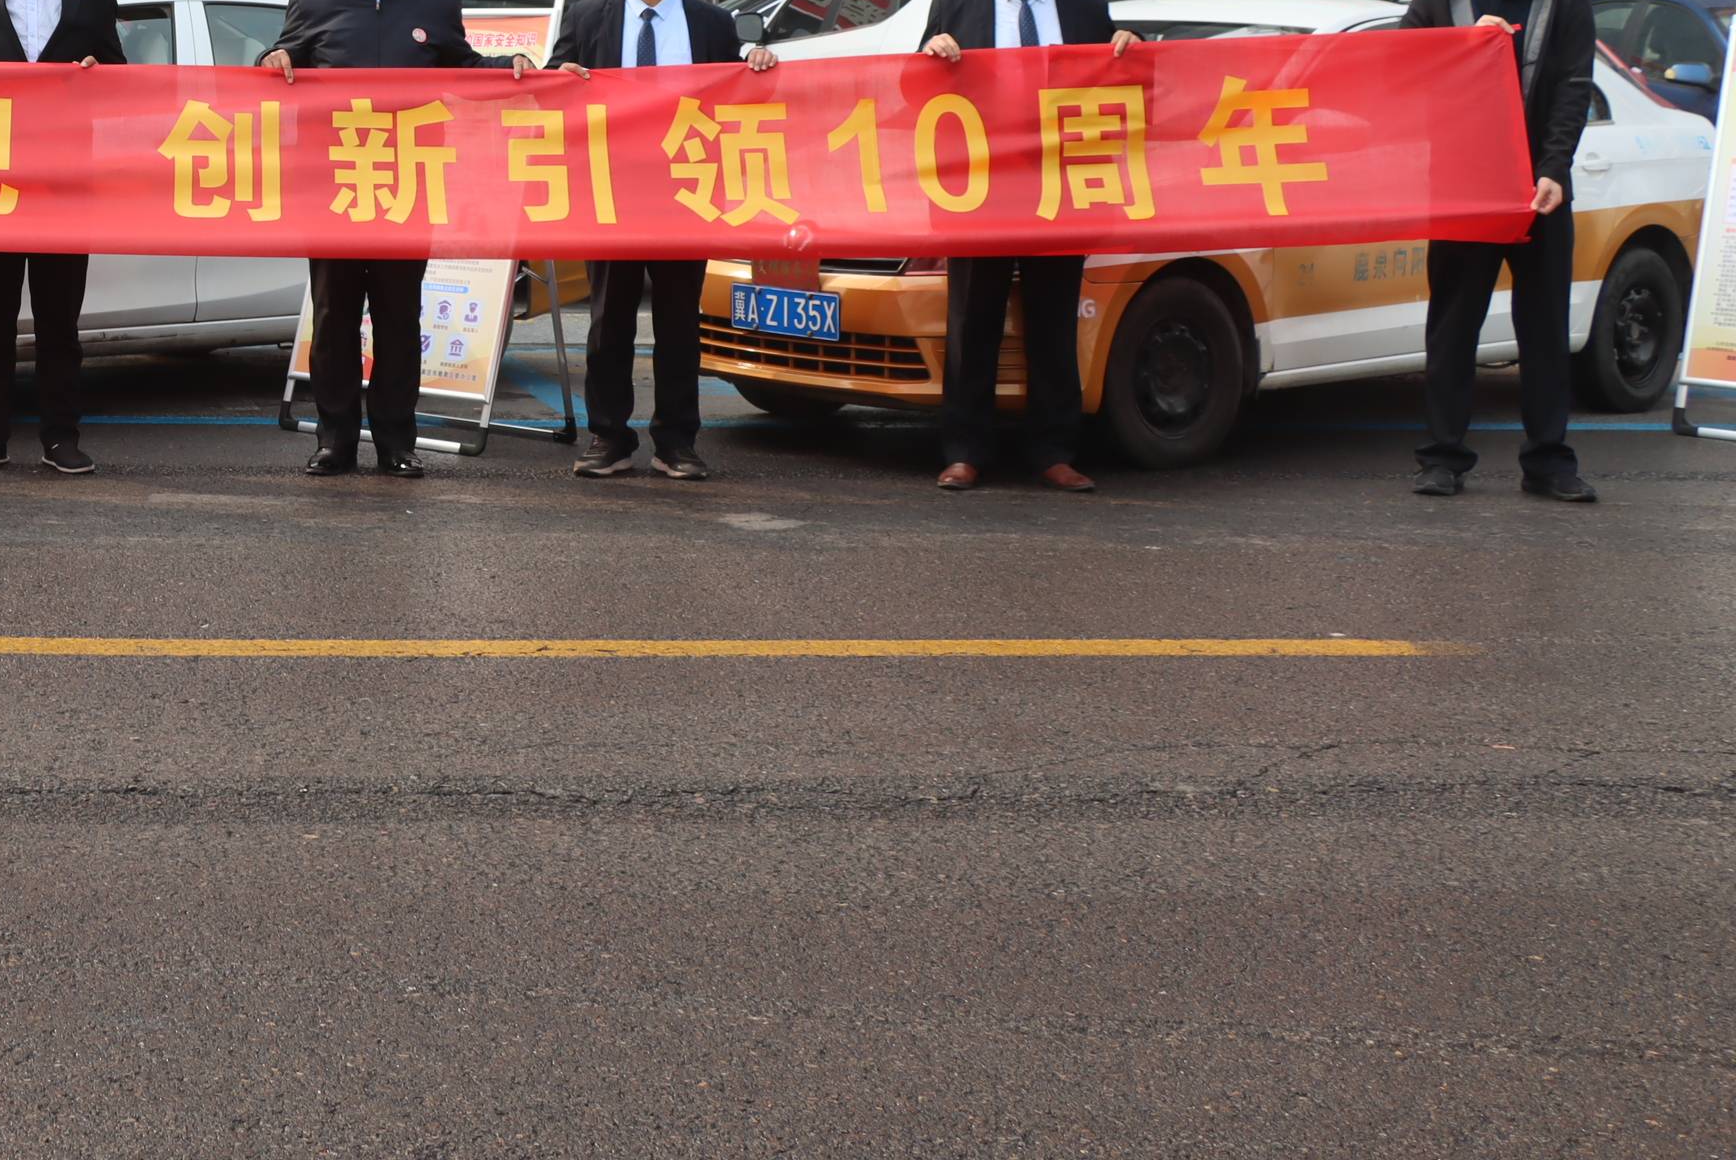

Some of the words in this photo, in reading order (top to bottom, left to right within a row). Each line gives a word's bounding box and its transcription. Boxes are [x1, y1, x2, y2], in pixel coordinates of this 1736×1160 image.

[158, 75, 1329, 227] 创新引领10周年
